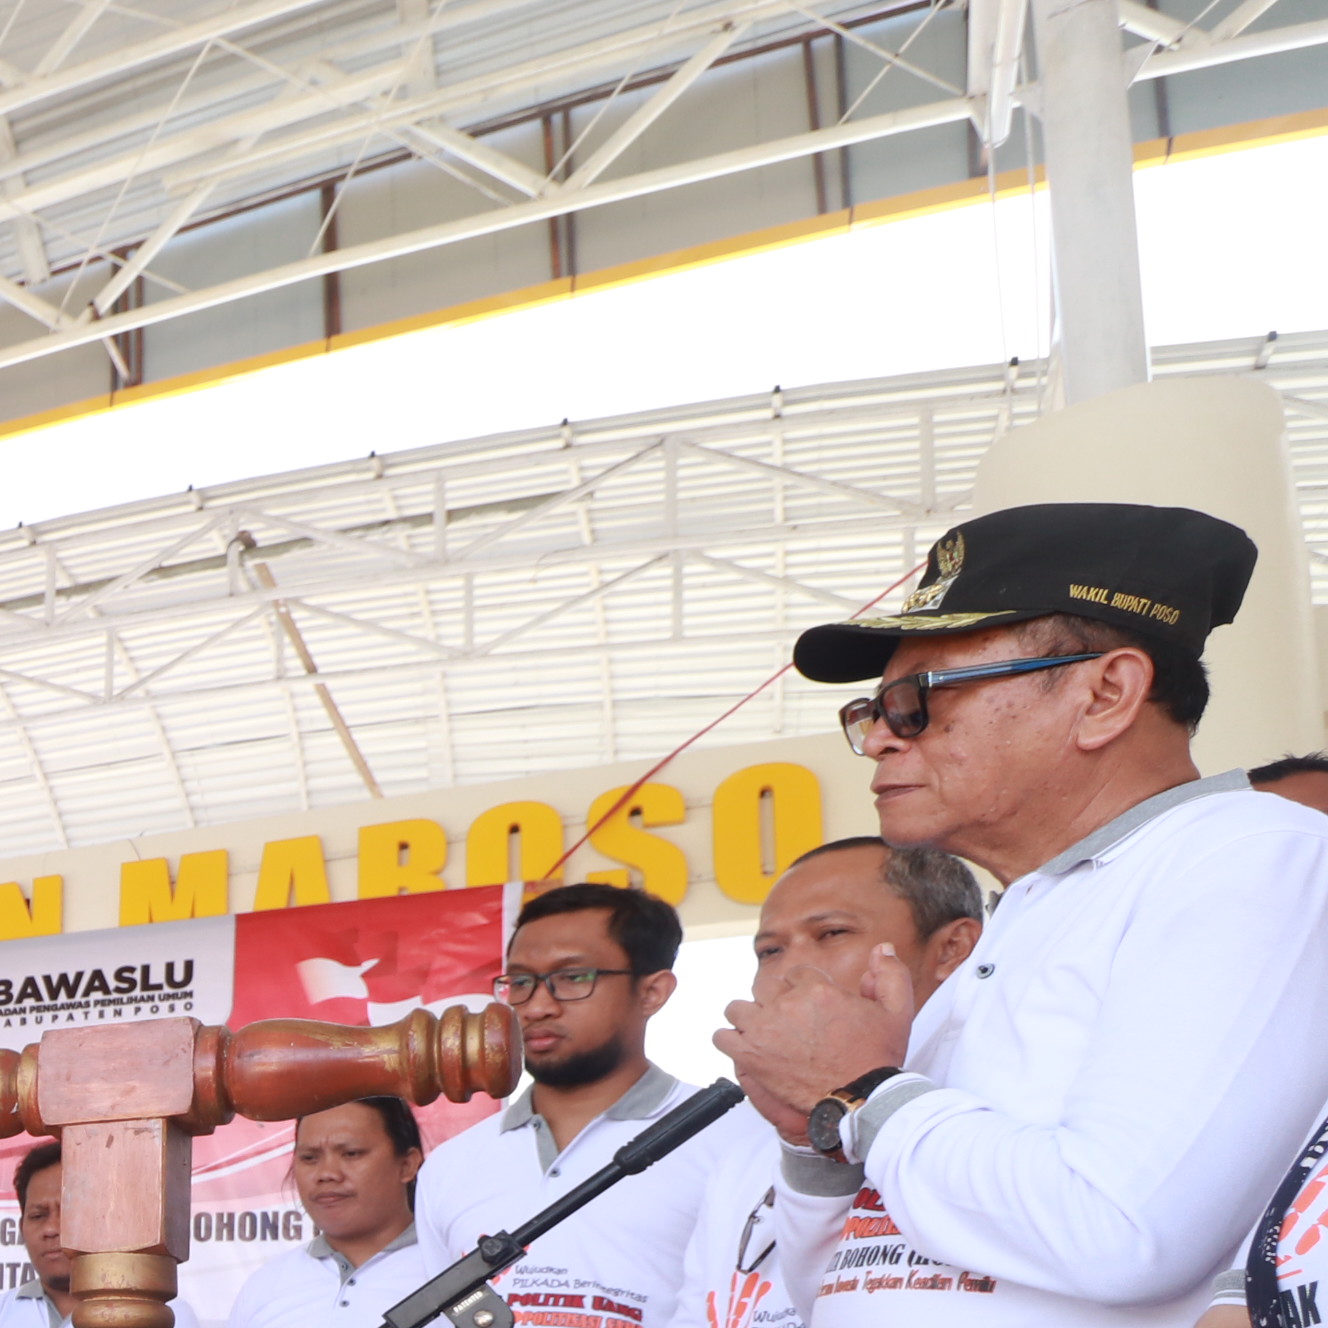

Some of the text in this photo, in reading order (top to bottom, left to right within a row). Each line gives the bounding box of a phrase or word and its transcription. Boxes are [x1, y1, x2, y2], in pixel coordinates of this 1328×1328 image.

[1069, 584, 1181, 625] WAKIL BUPATI POSO
[119, 762, 823, 927] MAROSO
[29, 1001, 91, 1014] PENGAWAS
[93, 994, 156, 1008] PEMILIHAN
[157, 990, 194, 1002] UMUM
[134, 1001, 194, 1016] POSO
[839, 1243, 907, 1271] BOHONG
[512, 1277, 571, 1289] PILKADA
[507, 1292, 643, 1322] POLITIK UANG
